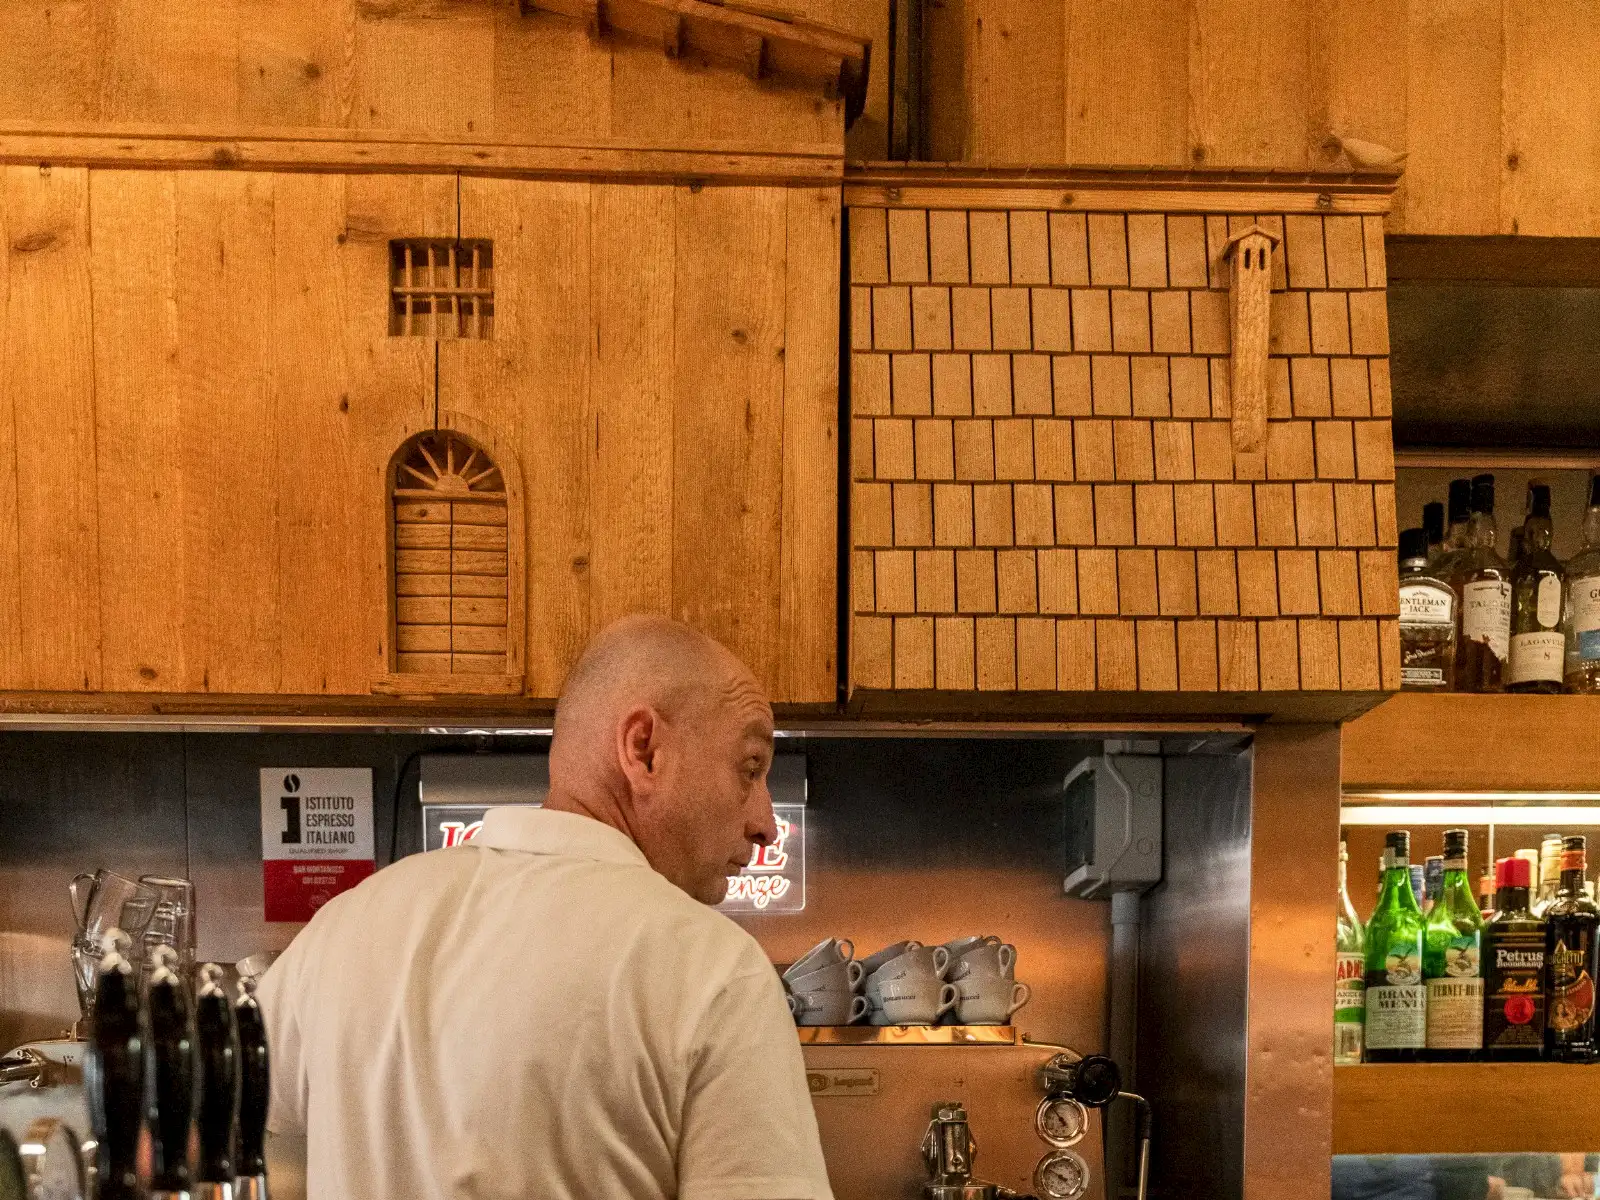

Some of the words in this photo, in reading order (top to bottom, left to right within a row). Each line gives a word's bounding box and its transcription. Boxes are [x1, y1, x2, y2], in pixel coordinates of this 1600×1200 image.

[1399, 598, 1446, 606] ENTLEMAN
[1409, 605, 1430, 613] JACK
[305, 796, 354, 810] ISTITUTO
[306, 813, 355, 828] ESPRESSO
[306, 831, 356, 845] ITALIANO
[1496, 948, 1544, 962] Petrus
